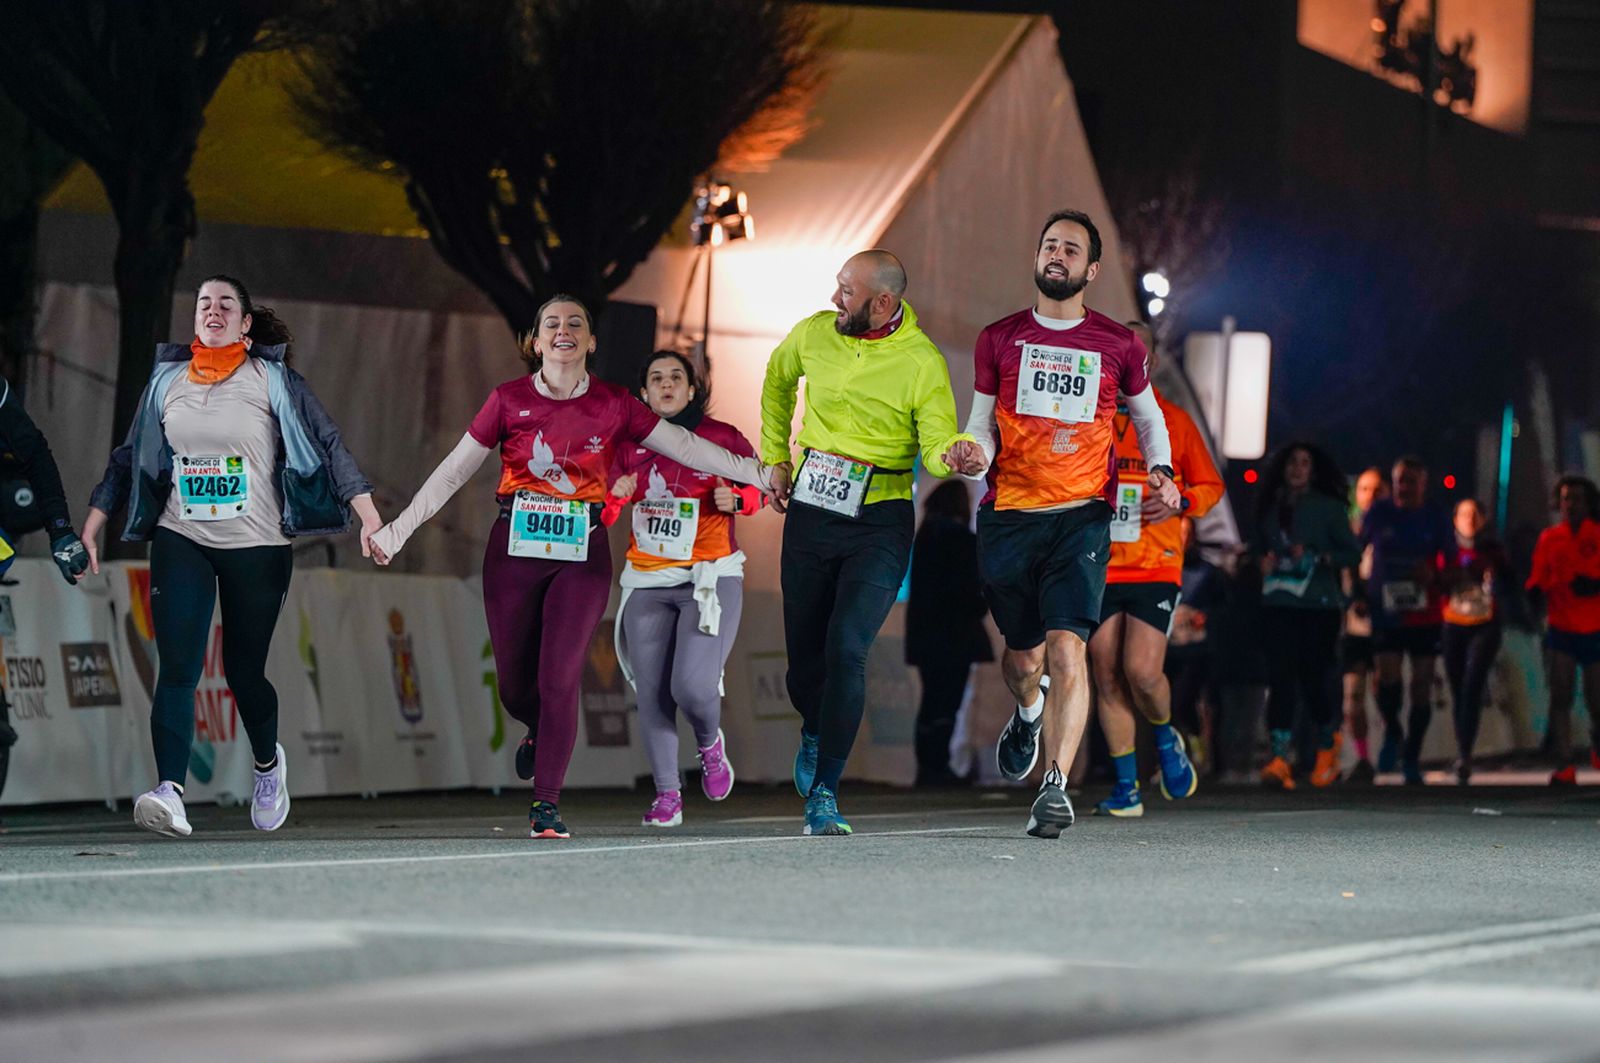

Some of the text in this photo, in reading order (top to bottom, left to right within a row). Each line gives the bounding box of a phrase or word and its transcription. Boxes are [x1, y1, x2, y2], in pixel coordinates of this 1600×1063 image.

[1040, 353, 1063, 362] NOCHE
[1064, 356, 1072, 364] DE
[1029, 360, 1045, 369] SAN
[1033, 370, 1086, 397] 6839
[190, 459, 212, 467] NOCHE
[183, 467, 198, 475] SAN
[185, 475, 241, 496] 12462
[529, 495, 553, 503] NOCHE
[520, 502, 537, 511] SAN
[526, 512, 574, 537] 9401
[647, 516, 681, 537] 1749
[7, 657, 45, 689] FISIO
